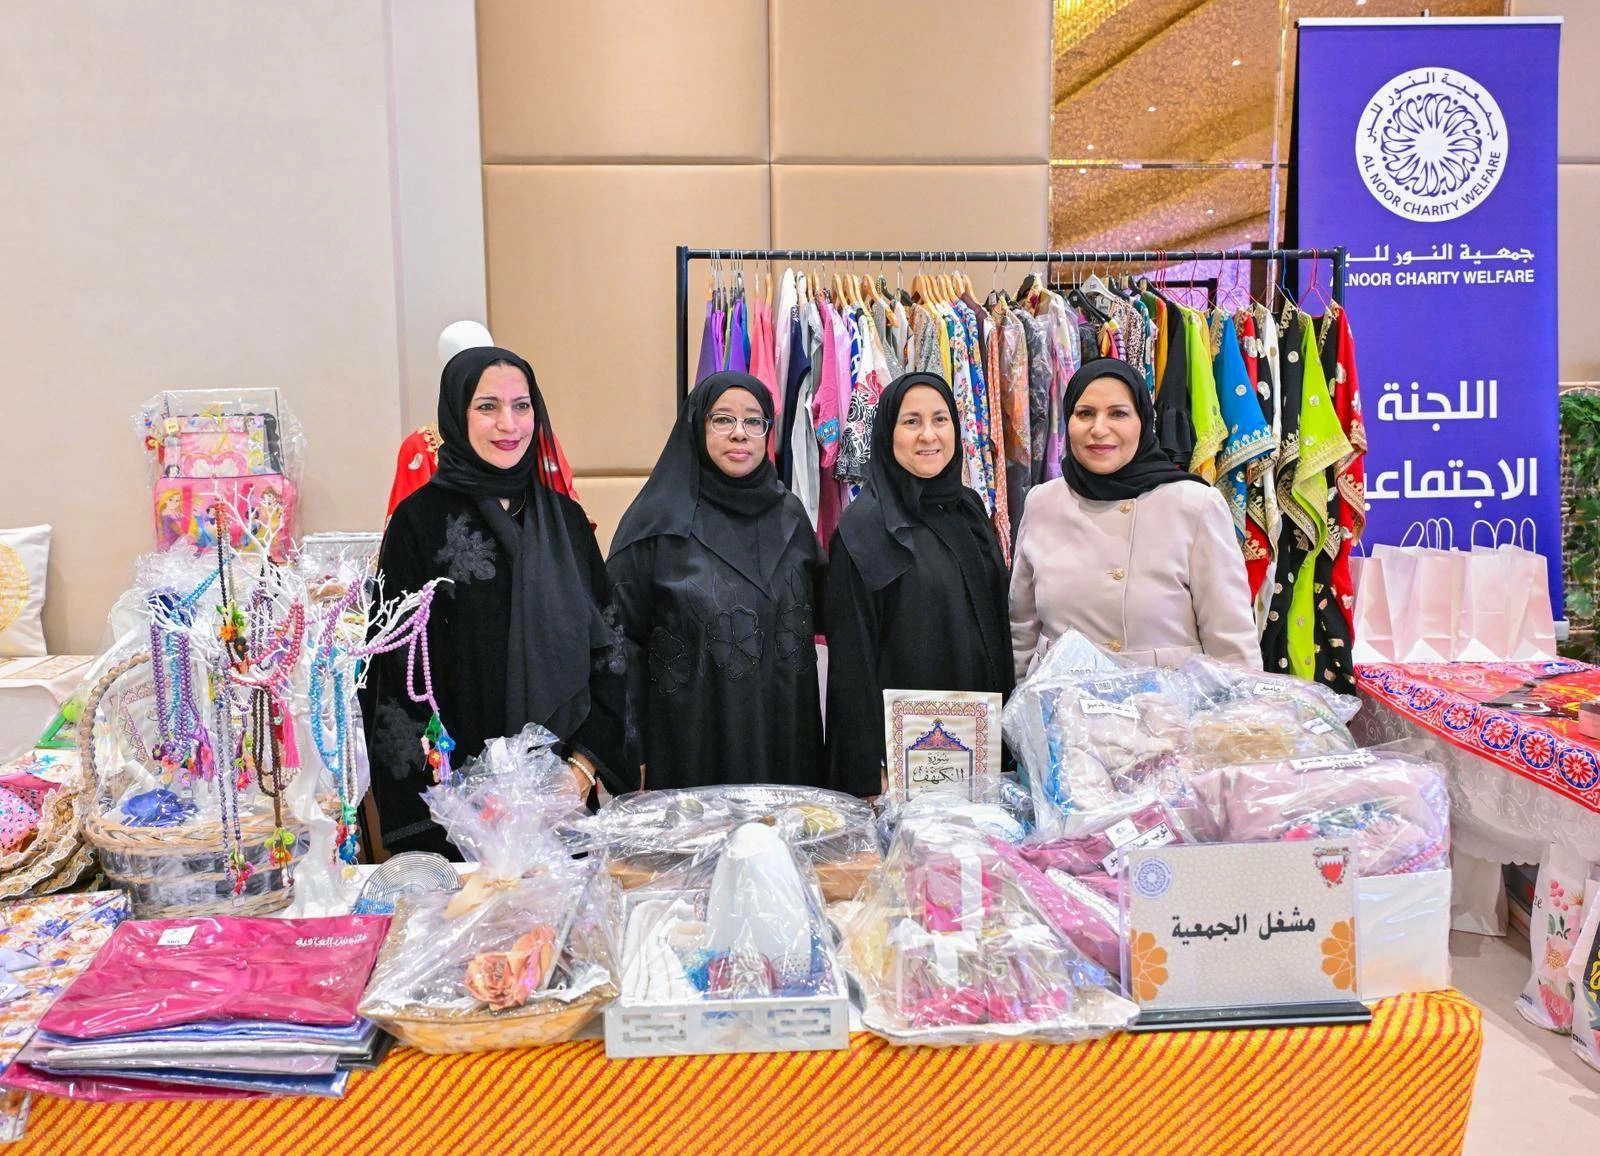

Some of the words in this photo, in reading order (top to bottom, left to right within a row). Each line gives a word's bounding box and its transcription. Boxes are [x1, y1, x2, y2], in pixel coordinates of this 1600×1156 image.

[1388, 71, 1435, 106] النور
[1366, 102, 1384, 143] للبر
[1441, 72, 1499, 141] جمعية
[1362, 154, 1374, 173] AL
[1369, 173, 1401, 207] NOOR
[1403, 199, 1460, 216] CHARITY
[1461, 151, 1501, 205] WELFARE
[1332, 244, 1389, 268] للب
[1392, 243, 1453, 266] النور
[1459, 243, 1535, 265] جمعية
[1395, 271, 1460, 286] CHARITY
[1463, 269, 1535, 284] WELFARE
[1377, 379, 1498, 432] اللجنة
[1171, 912, 1247, 945] الجمعية
[1258, 906, 1316, 940] مشغل
